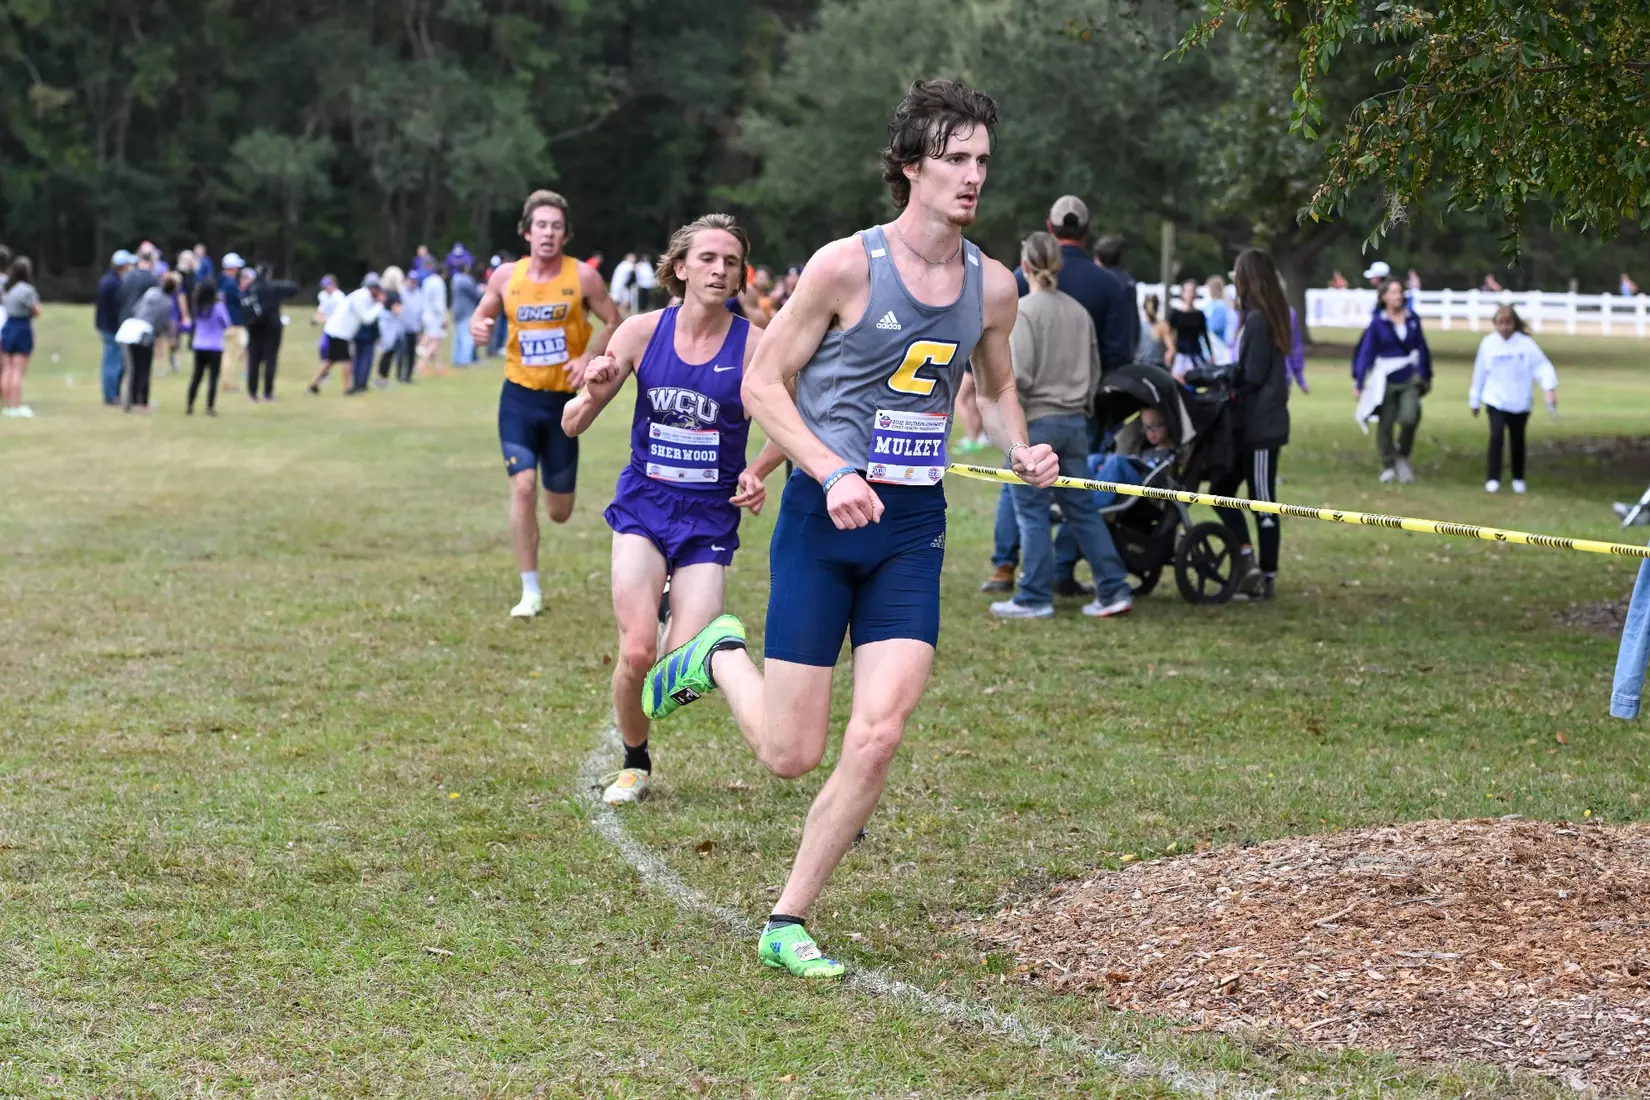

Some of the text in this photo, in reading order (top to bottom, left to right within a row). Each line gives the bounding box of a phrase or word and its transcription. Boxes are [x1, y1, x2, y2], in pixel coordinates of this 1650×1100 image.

[517, 304, 568, 322] UNCG
[876, 322, 902, 331] adidas
[521, 338, 566, 355] WARD
[885, 337, 960, 398] C
[647, 387, 720, 424] WCU
[650, 444, 717, 462] SHERWOOD
[874, 436, 941, 456] MULKEY
